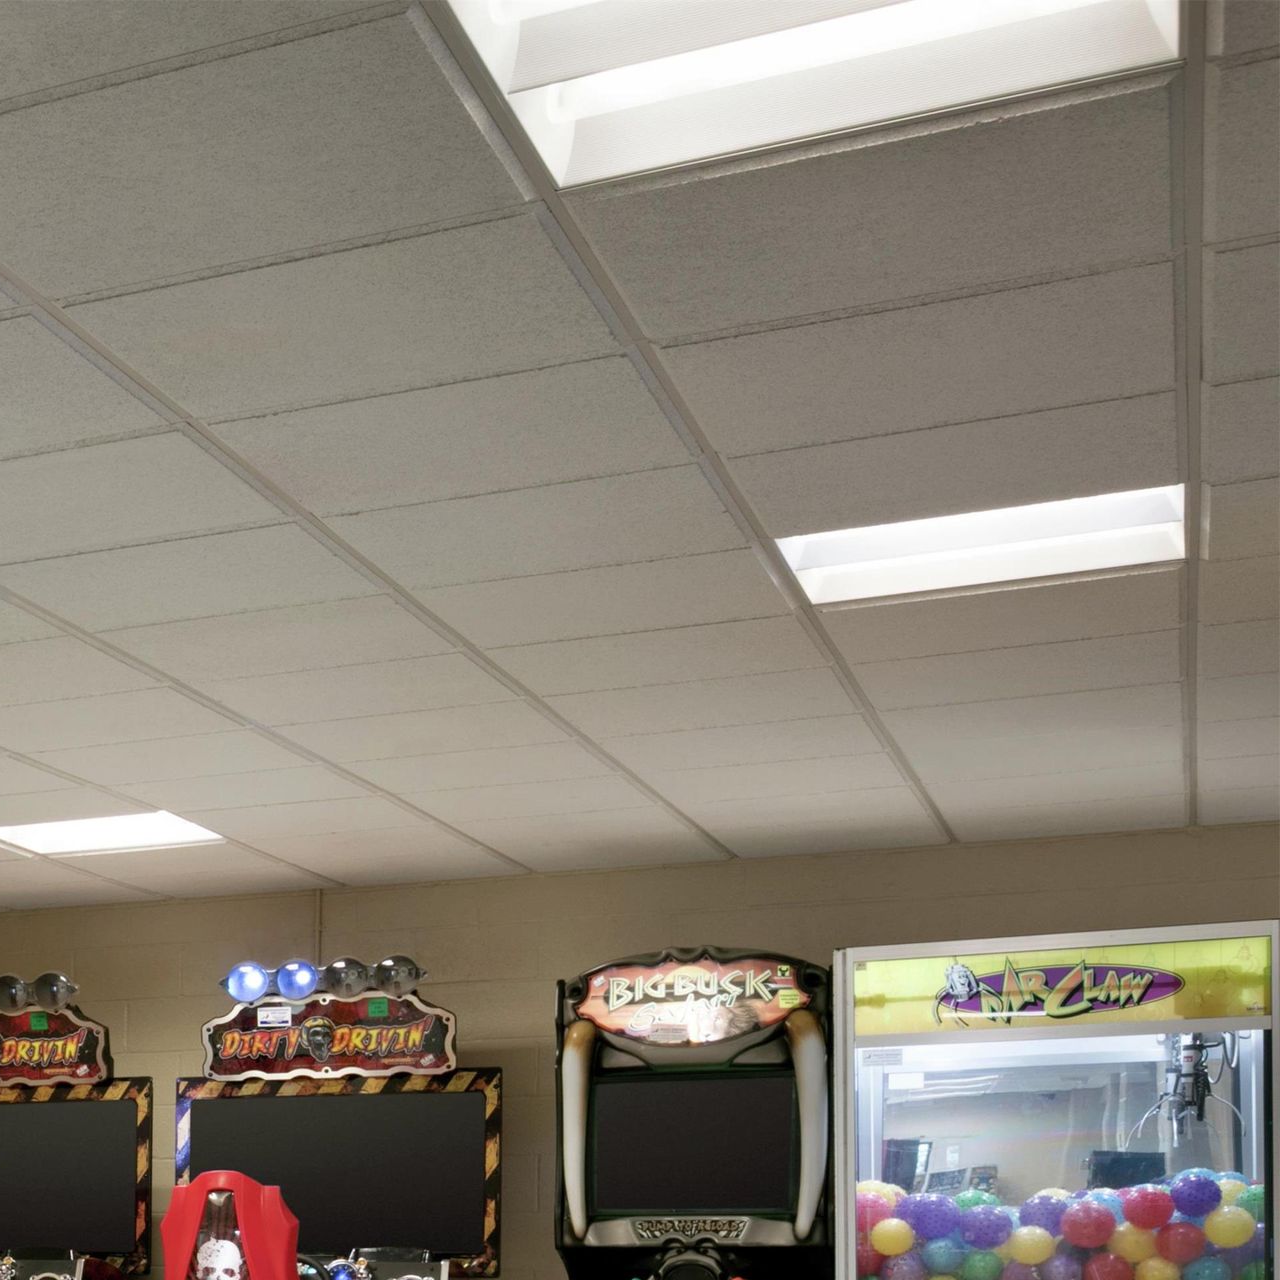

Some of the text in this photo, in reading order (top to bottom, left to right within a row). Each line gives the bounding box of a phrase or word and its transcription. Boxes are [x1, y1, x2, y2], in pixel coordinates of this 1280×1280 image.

[609, 969, 774, 1012] BIG BUCK
[1045, 958, 1153, 1019] CLAW
[220, 1028, 301, 1060] DIRTY
[641, 1220, 673, 1231] PUMP
